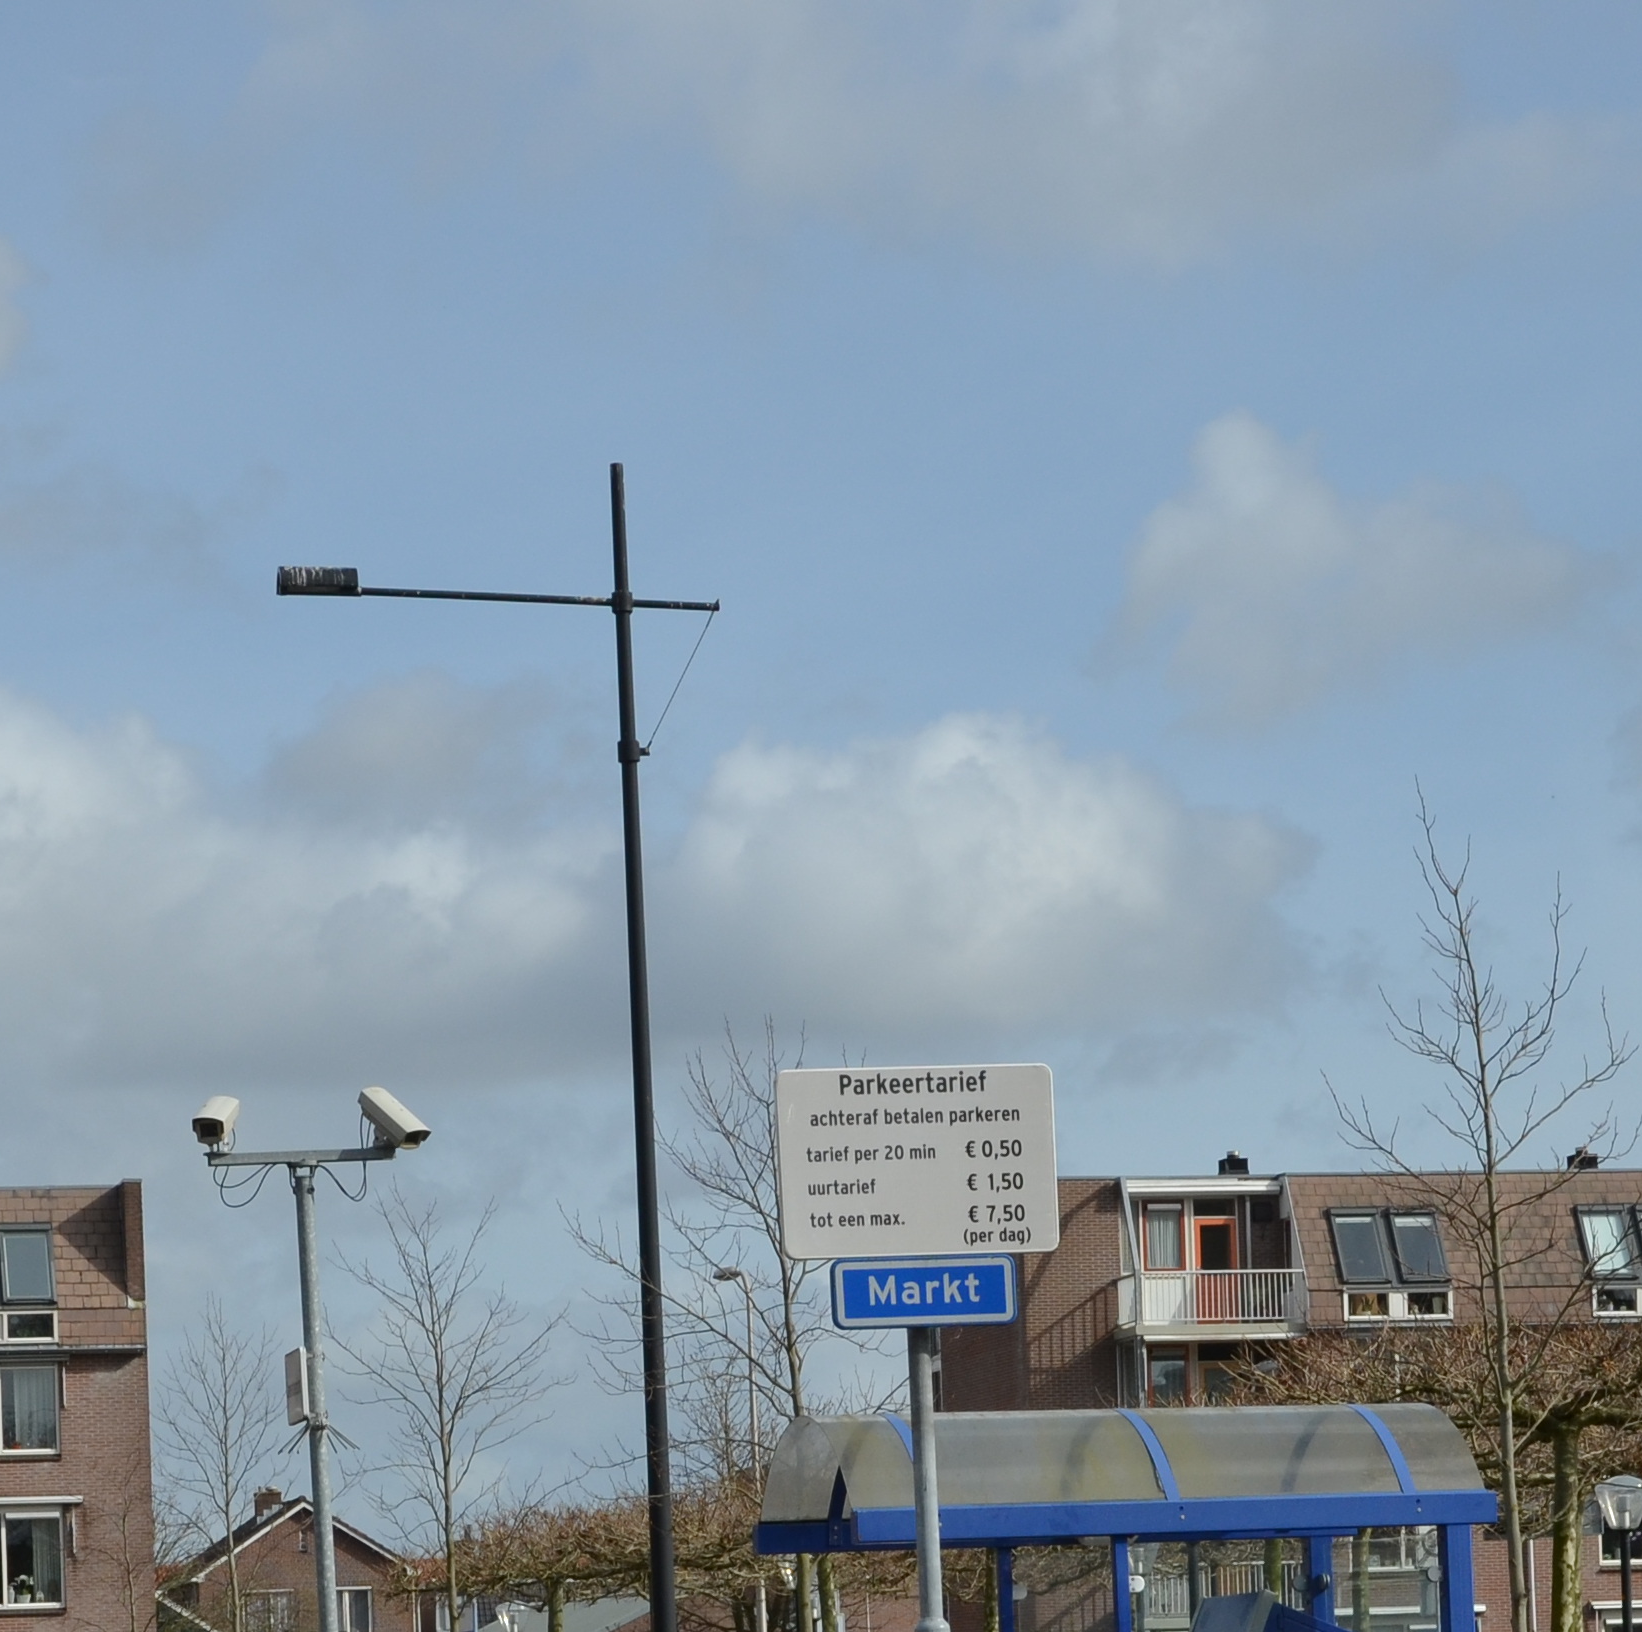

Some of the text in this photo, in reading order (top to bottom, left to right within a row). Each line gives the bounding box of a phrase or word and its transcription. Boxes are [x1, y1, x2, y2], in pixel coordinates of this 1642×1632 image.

[839, 1070, 987, 1096] Parkeertarief
[810, 1106, 1020, 1127] achteraf betalen parkeren
[806, 1146, 849, 1163] tarief
[854, 1148, 879, 1164] per
[884, 1145, 905, 1161] 20
[909, 1144, 936, 1160] min
[981, 1139, 1023, 1160] 0,50
[807, 1179, 876, 1196] uurtarief
[987, 1172, 1024, 1193] 1,50
[810, 1212, 833, 1228] tot
[838, 1214, 865, 1227] een
[870, 1212, 906, 1227] max.
[986, 1204, 1026, 1225] 7,50
[963, 1226, 1032, 1246] (per dag)
[868, 1273, 981, 1306] Markt
